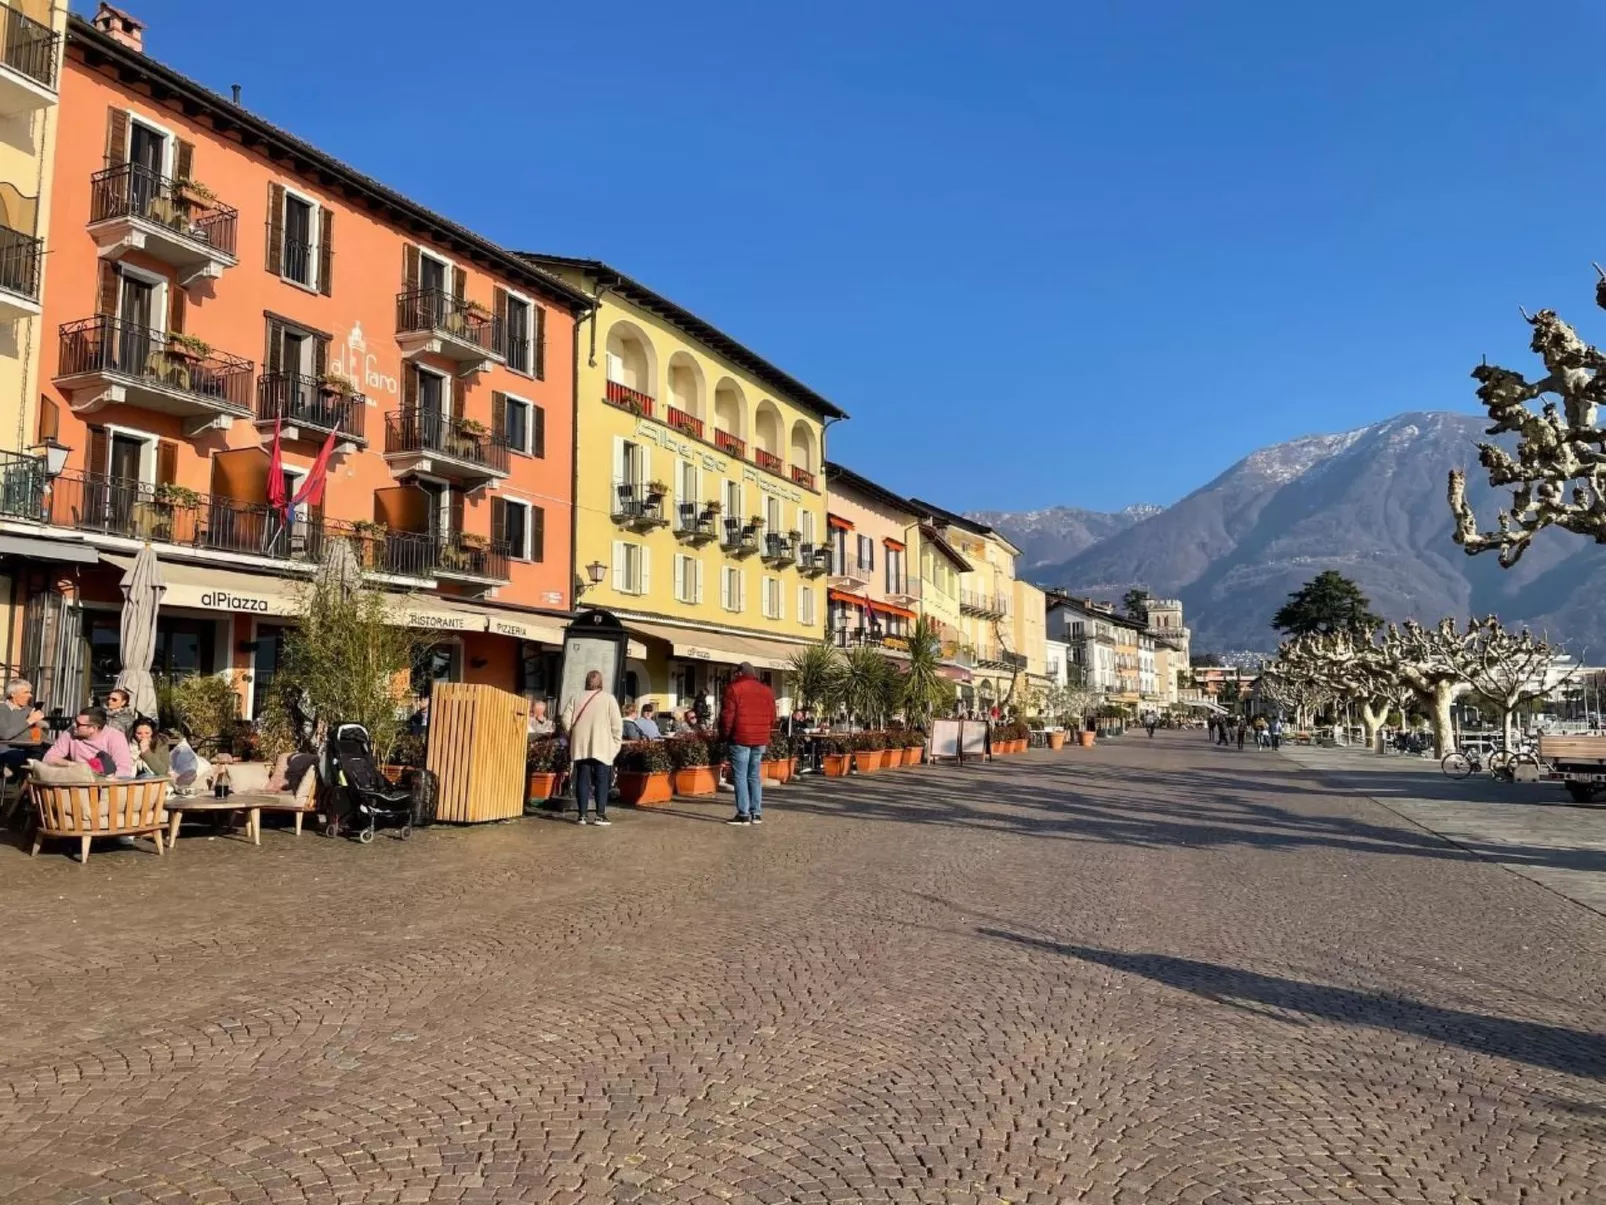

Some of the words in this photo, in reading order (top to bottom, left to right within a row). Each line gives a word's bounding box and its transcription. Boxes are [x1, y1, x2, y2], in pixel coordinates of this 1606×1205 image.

[201, 592, 268, 612] alPiazza
[409, 614, 465, 629] RISTORANTE
[497, 623, 527, 636] PIZZERIA
